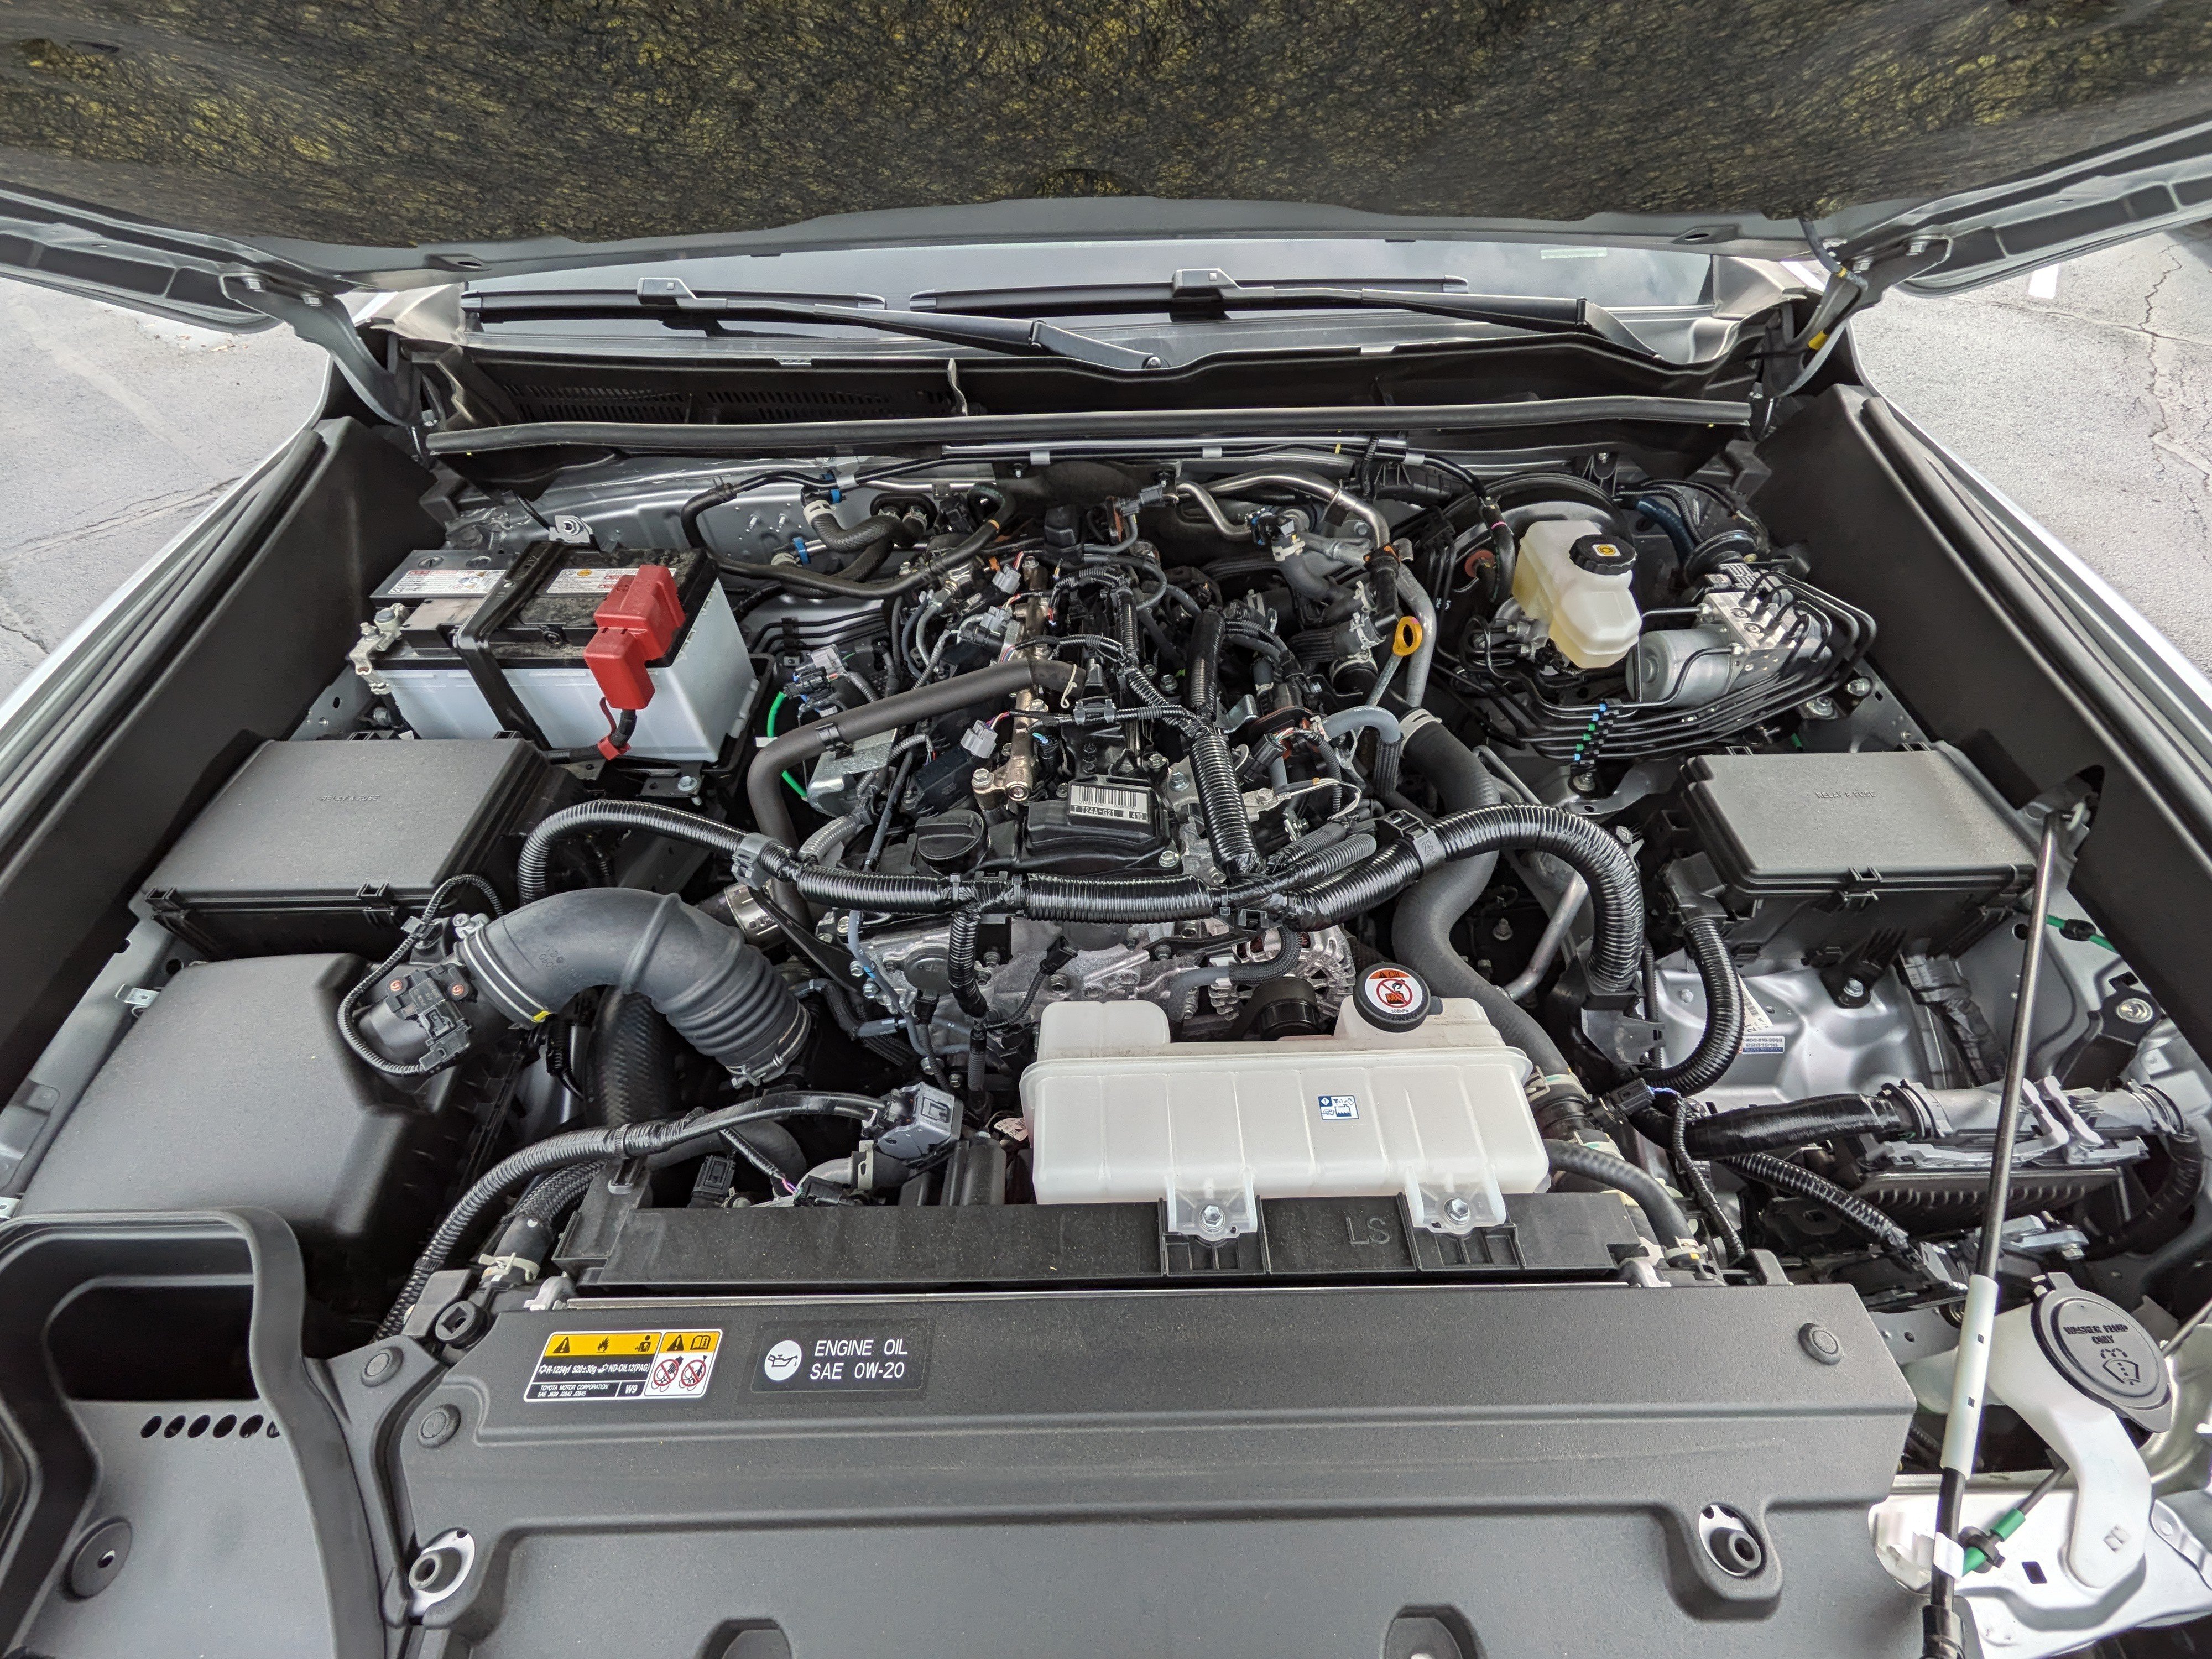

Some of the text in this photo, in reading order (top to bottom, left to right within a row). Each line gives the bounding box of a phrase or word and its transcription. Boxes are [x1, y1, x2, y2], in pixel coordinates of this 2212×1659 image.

[1082, 806, 1115, 817] T24A-G21
[1346, 1217, 1390, 1244] LS
[814, 1339, 908, 1357] ENGINE OIL
[546, 1364, 572, 1375] R-1234yf
[572, 1364, 597, 1375] 520±30g
[810, 1361, 905, 1380] SAE 0W-20
[625, 1384, 638, 1394] W9
